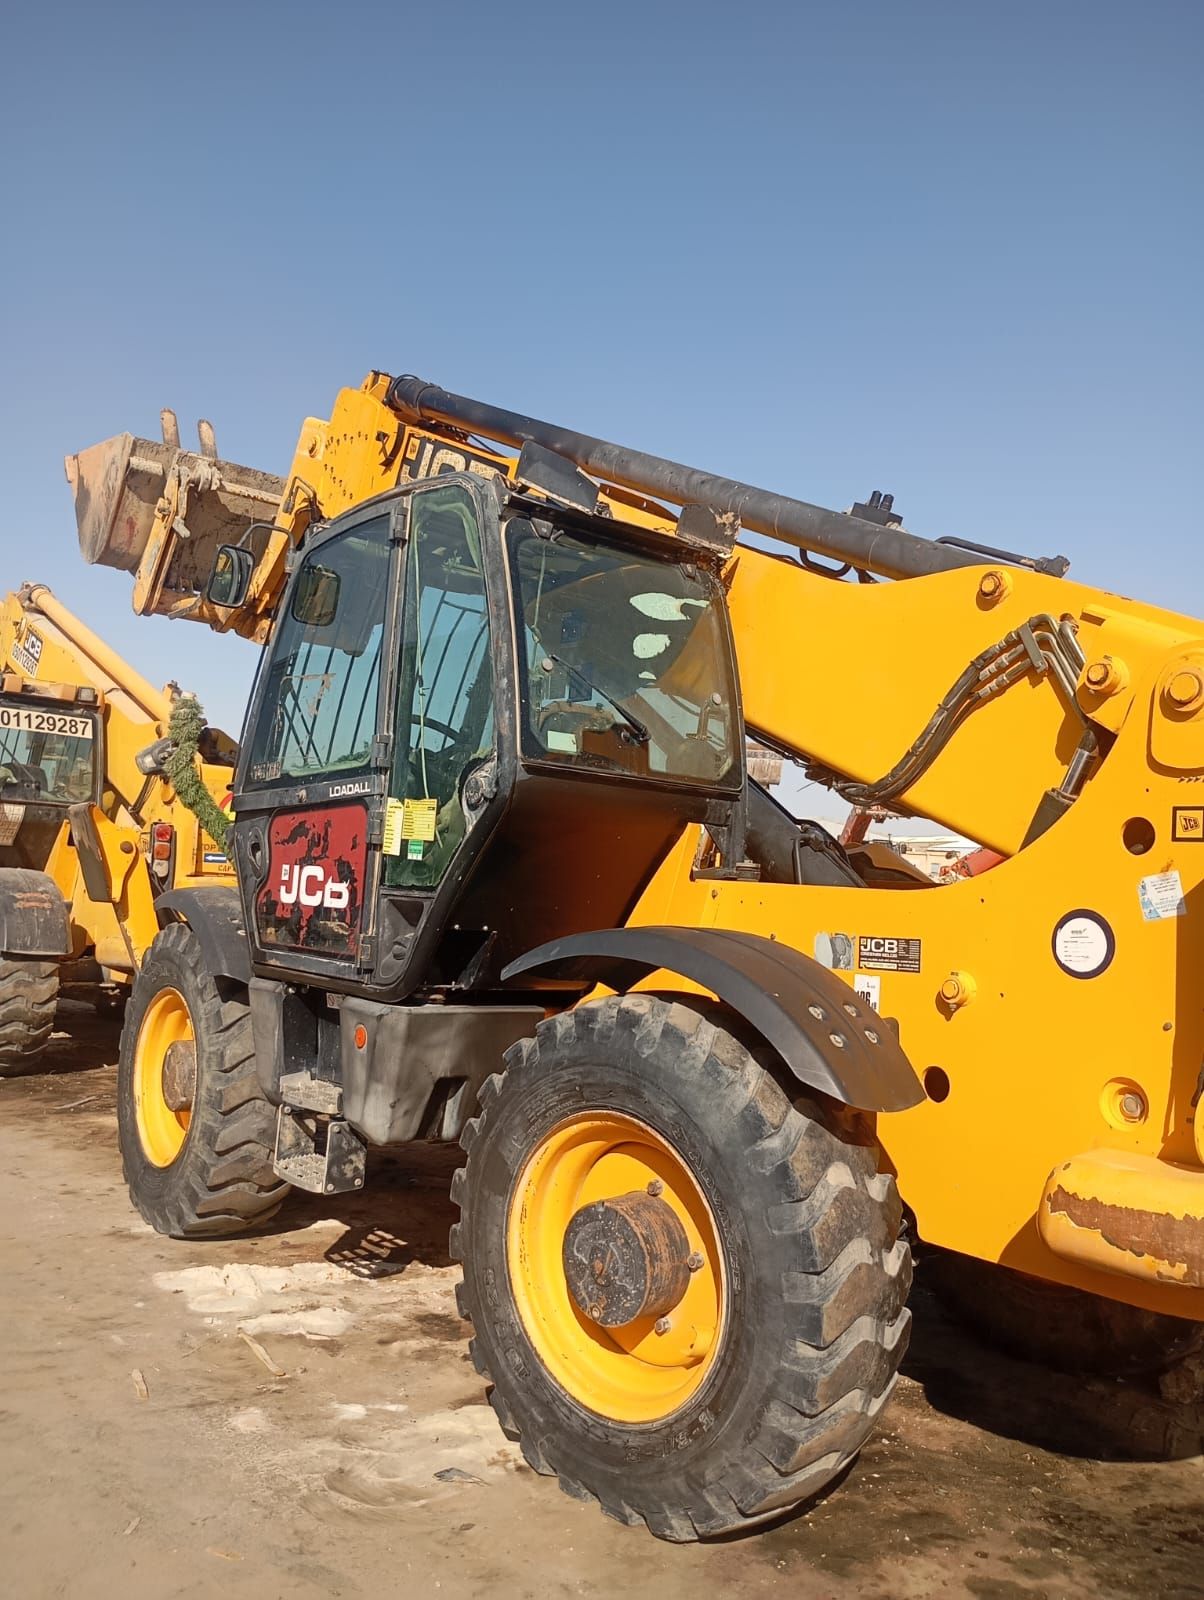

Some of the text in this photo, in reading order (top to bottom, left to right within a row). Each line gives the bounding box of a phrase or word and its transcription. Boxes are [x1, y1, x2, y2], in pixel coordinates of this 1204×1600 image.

[25, 633, 41, 660] JCB
[0, 711, 90, 736] 01129287
[329, 781, 371, 798] LOADALL
[1183, 816, 1201, 831] JCB
[860, 938, 898, 954] JCB
